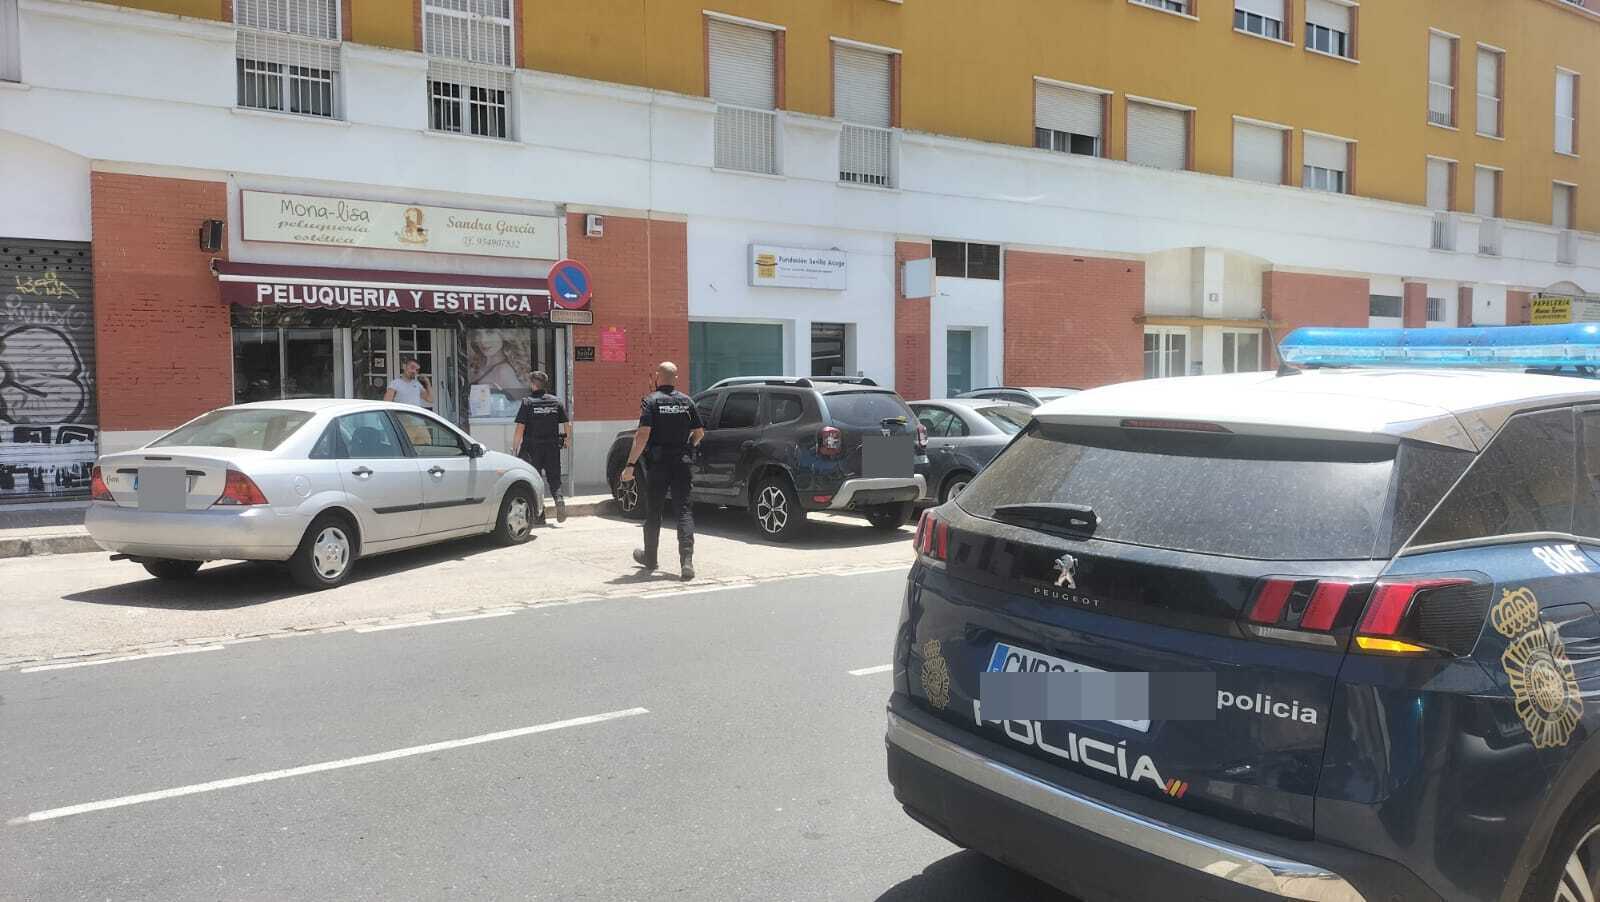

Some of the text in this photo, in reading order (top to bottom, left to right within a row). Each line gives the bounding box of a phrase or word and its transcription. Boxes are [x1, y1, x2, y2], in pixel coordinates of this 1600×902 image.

[281, 199, 370, 223] Mona-lisa
[446, 215, 536, 235] Sandra García
[256, 284, 532, 312] PELUQUERIA Y ESTETICA
[1033, 586, 1101, 608] PEUGEOT
[1217, 690, 1317, 725] policia
